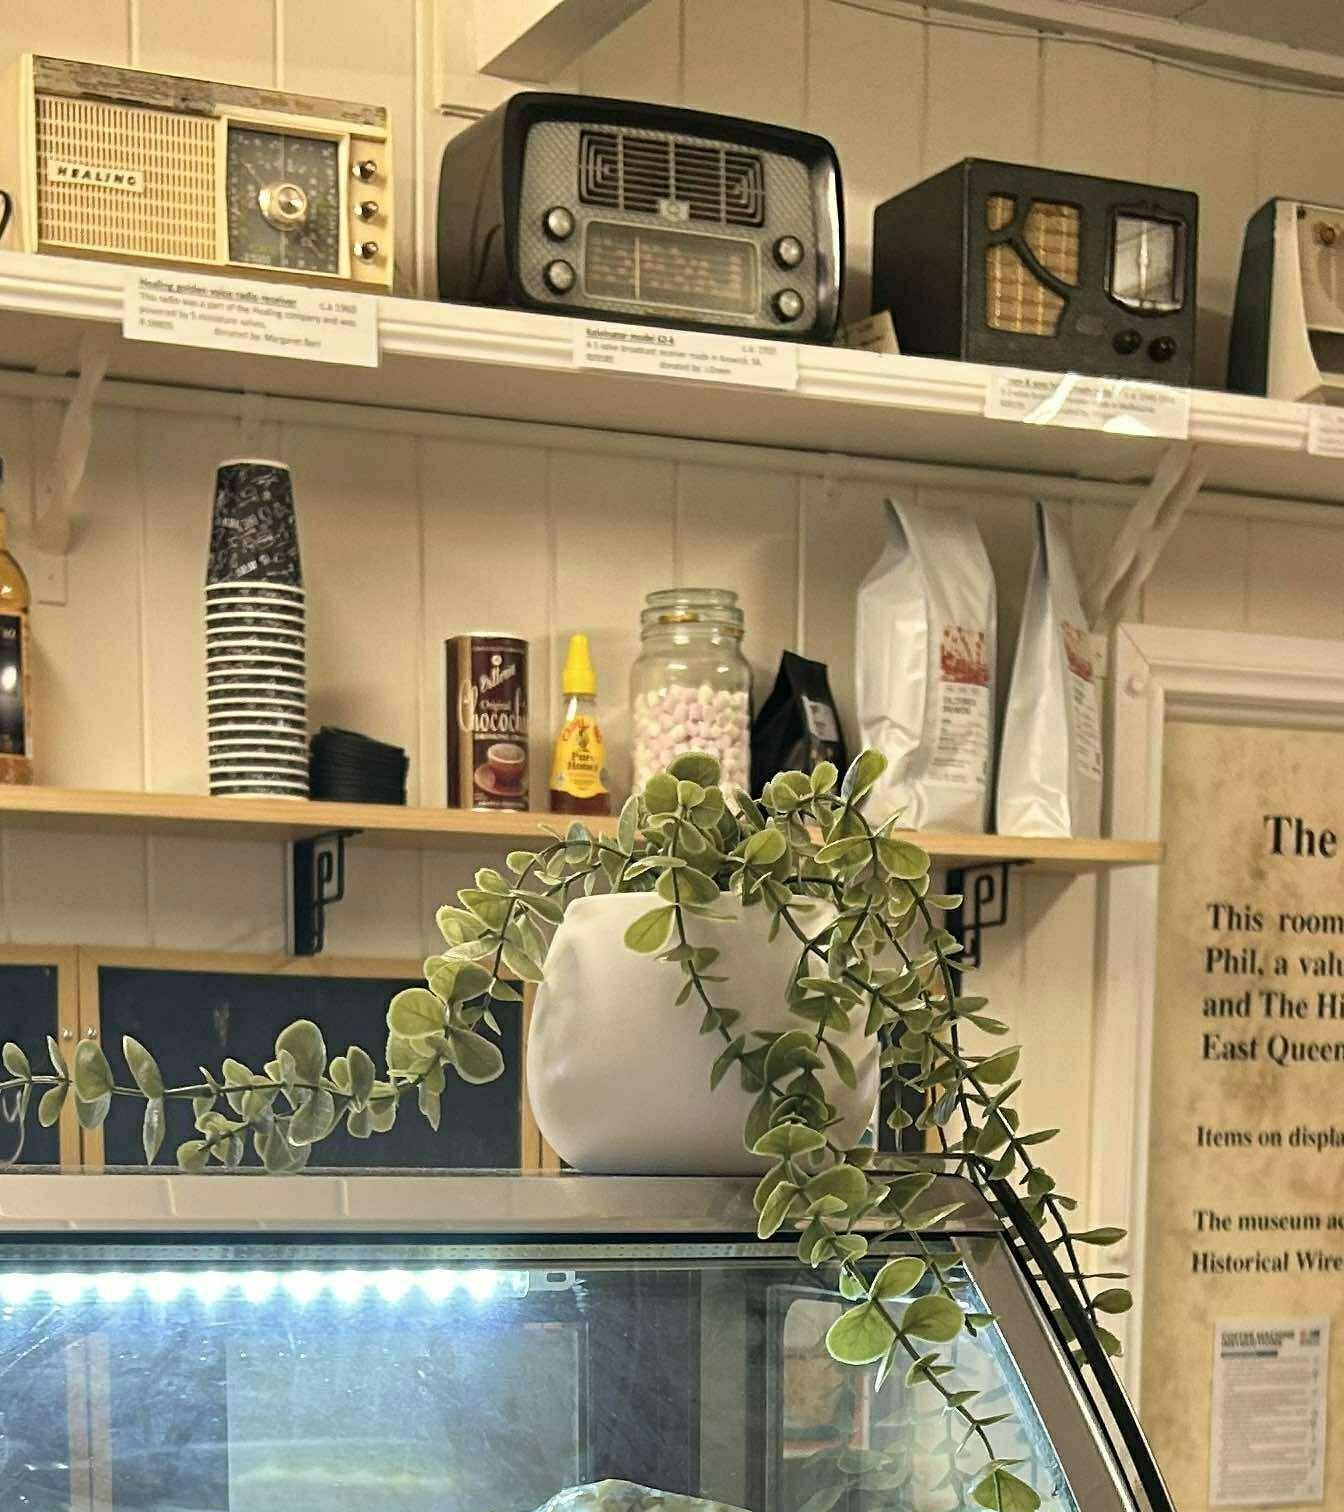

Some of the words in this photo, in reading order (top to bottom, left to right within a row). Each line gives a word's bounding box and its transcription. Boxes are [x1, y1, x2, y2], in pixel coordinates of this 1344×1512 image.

[57, 165, 139, 188] HEALING
[1263, 814, 1338, 859] The
[1207, 903, 1264, 933] This
[1278, 912, 1344, 935] room
[1205, 946, 1266, 979] Phil,
[1273, 957, 1289, 977] a
[1202, 992, 1251, 1018] and
[1258, 991, 1309, 1019] The
[1201, 1033, 1258, 1061] East
[1196, 1125, 1252, 1149] Items
[1258, 1130, 1282, 1148] on
[1193, 1208, 1233, 1233] The
[1237, 1212, 1321, 1232] museum
[1191, 1249, 1290, 1274] Historical
